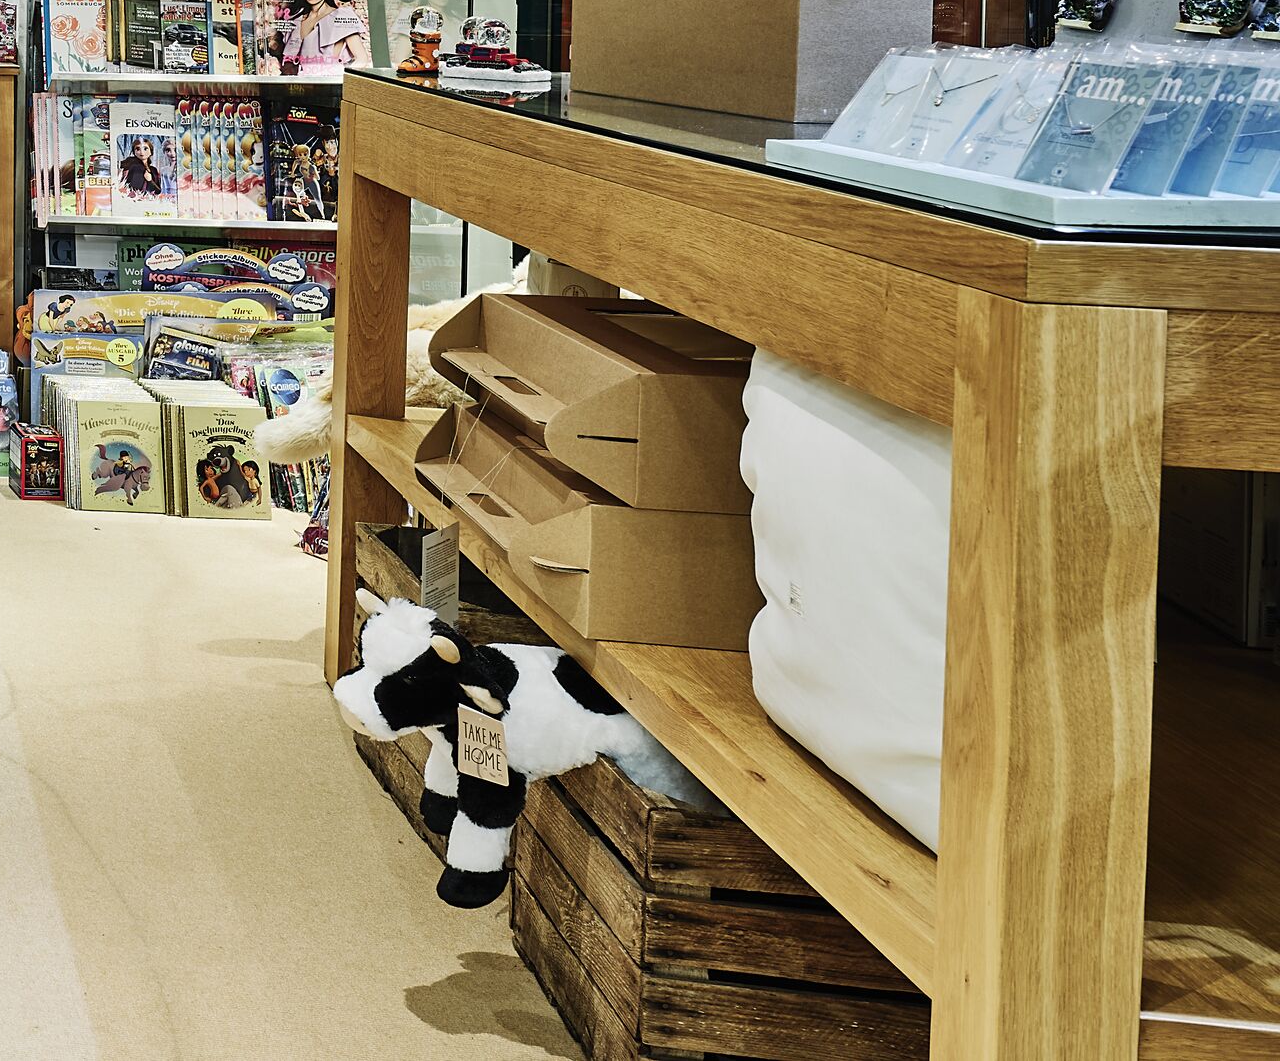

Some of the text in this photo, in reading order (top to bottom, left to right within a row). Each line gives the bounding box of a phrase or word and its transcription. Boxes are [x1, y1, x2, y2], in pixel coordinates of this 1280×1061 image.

[1077, 76, 1145, 106] am...
[145, 108, 162, 117] Disney
[290, 110, 306, 118] TOY
[197, 254, 258, 268] Sticker-Album
[278, 261, 300, 272] Qualität
[271, 267, 300, 279] Einsparung
[301, 292, 323, 300] Qualität
[145, 296, 180, 308] Disney
[296, 298, 323, 307] Einsparung
[117, 308, 135, 317] Die
[118, 355, 124, 363] 5
[186, 357, 210, 369] FILM
[216, 418, 235, 426] Das
[462, 721, 502, 749] TAKE ME
[464, 746, 502, 772] HOME
